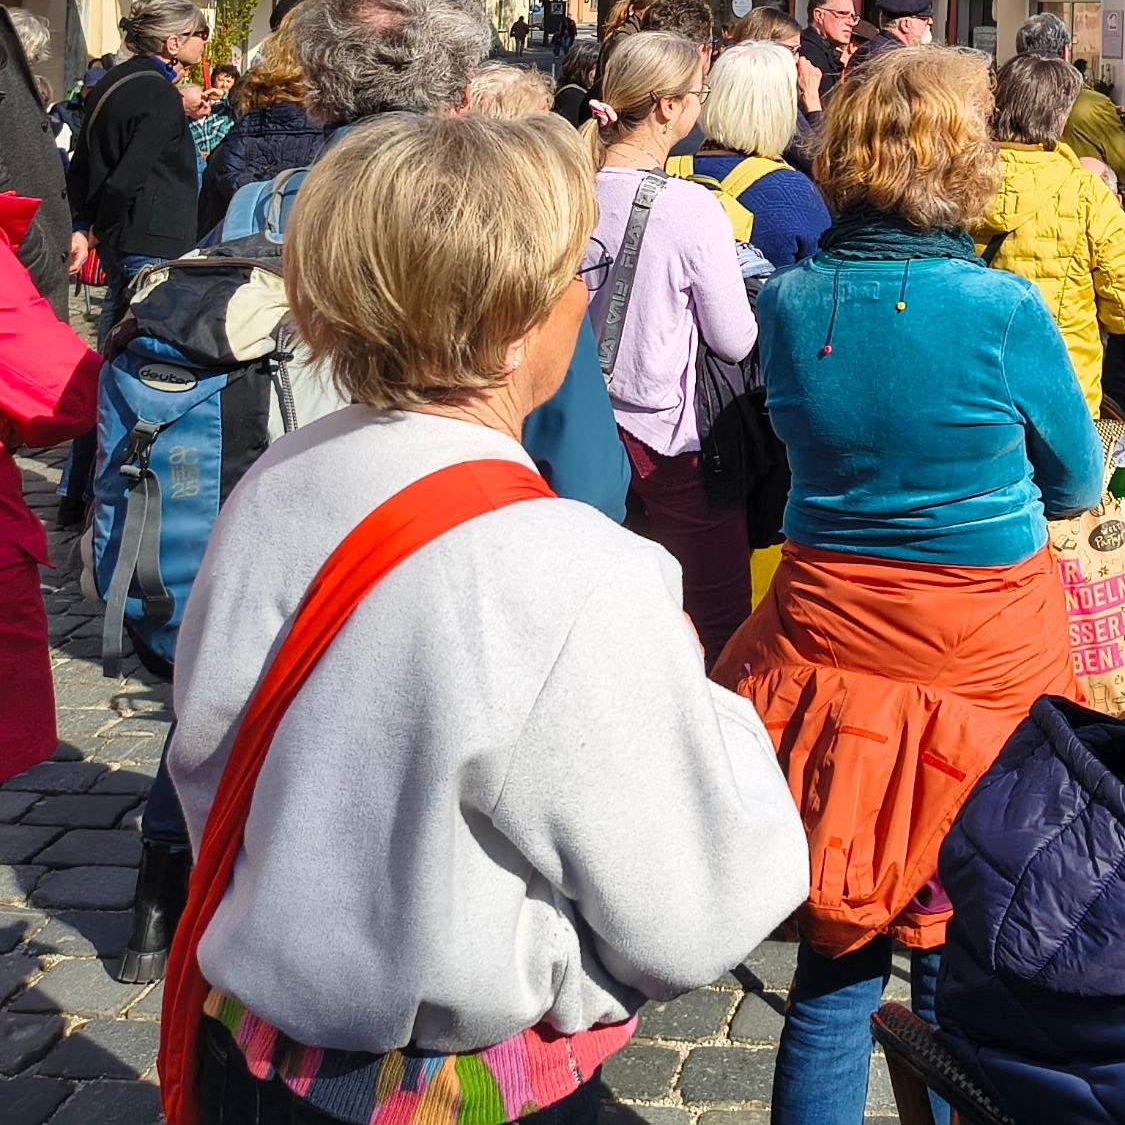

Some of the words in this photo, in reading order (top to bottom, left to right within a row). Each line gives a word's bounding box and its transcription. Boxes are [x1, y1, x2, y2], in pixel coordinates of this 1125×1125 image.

[620, 225, 643, 269] FILA
[606, 280, 629, 326] FILA
[140, 368, 195, 386] deuter
[1069, 616, 1121, 646] SSER
[1073, 647, 1120, 674] BEN.
